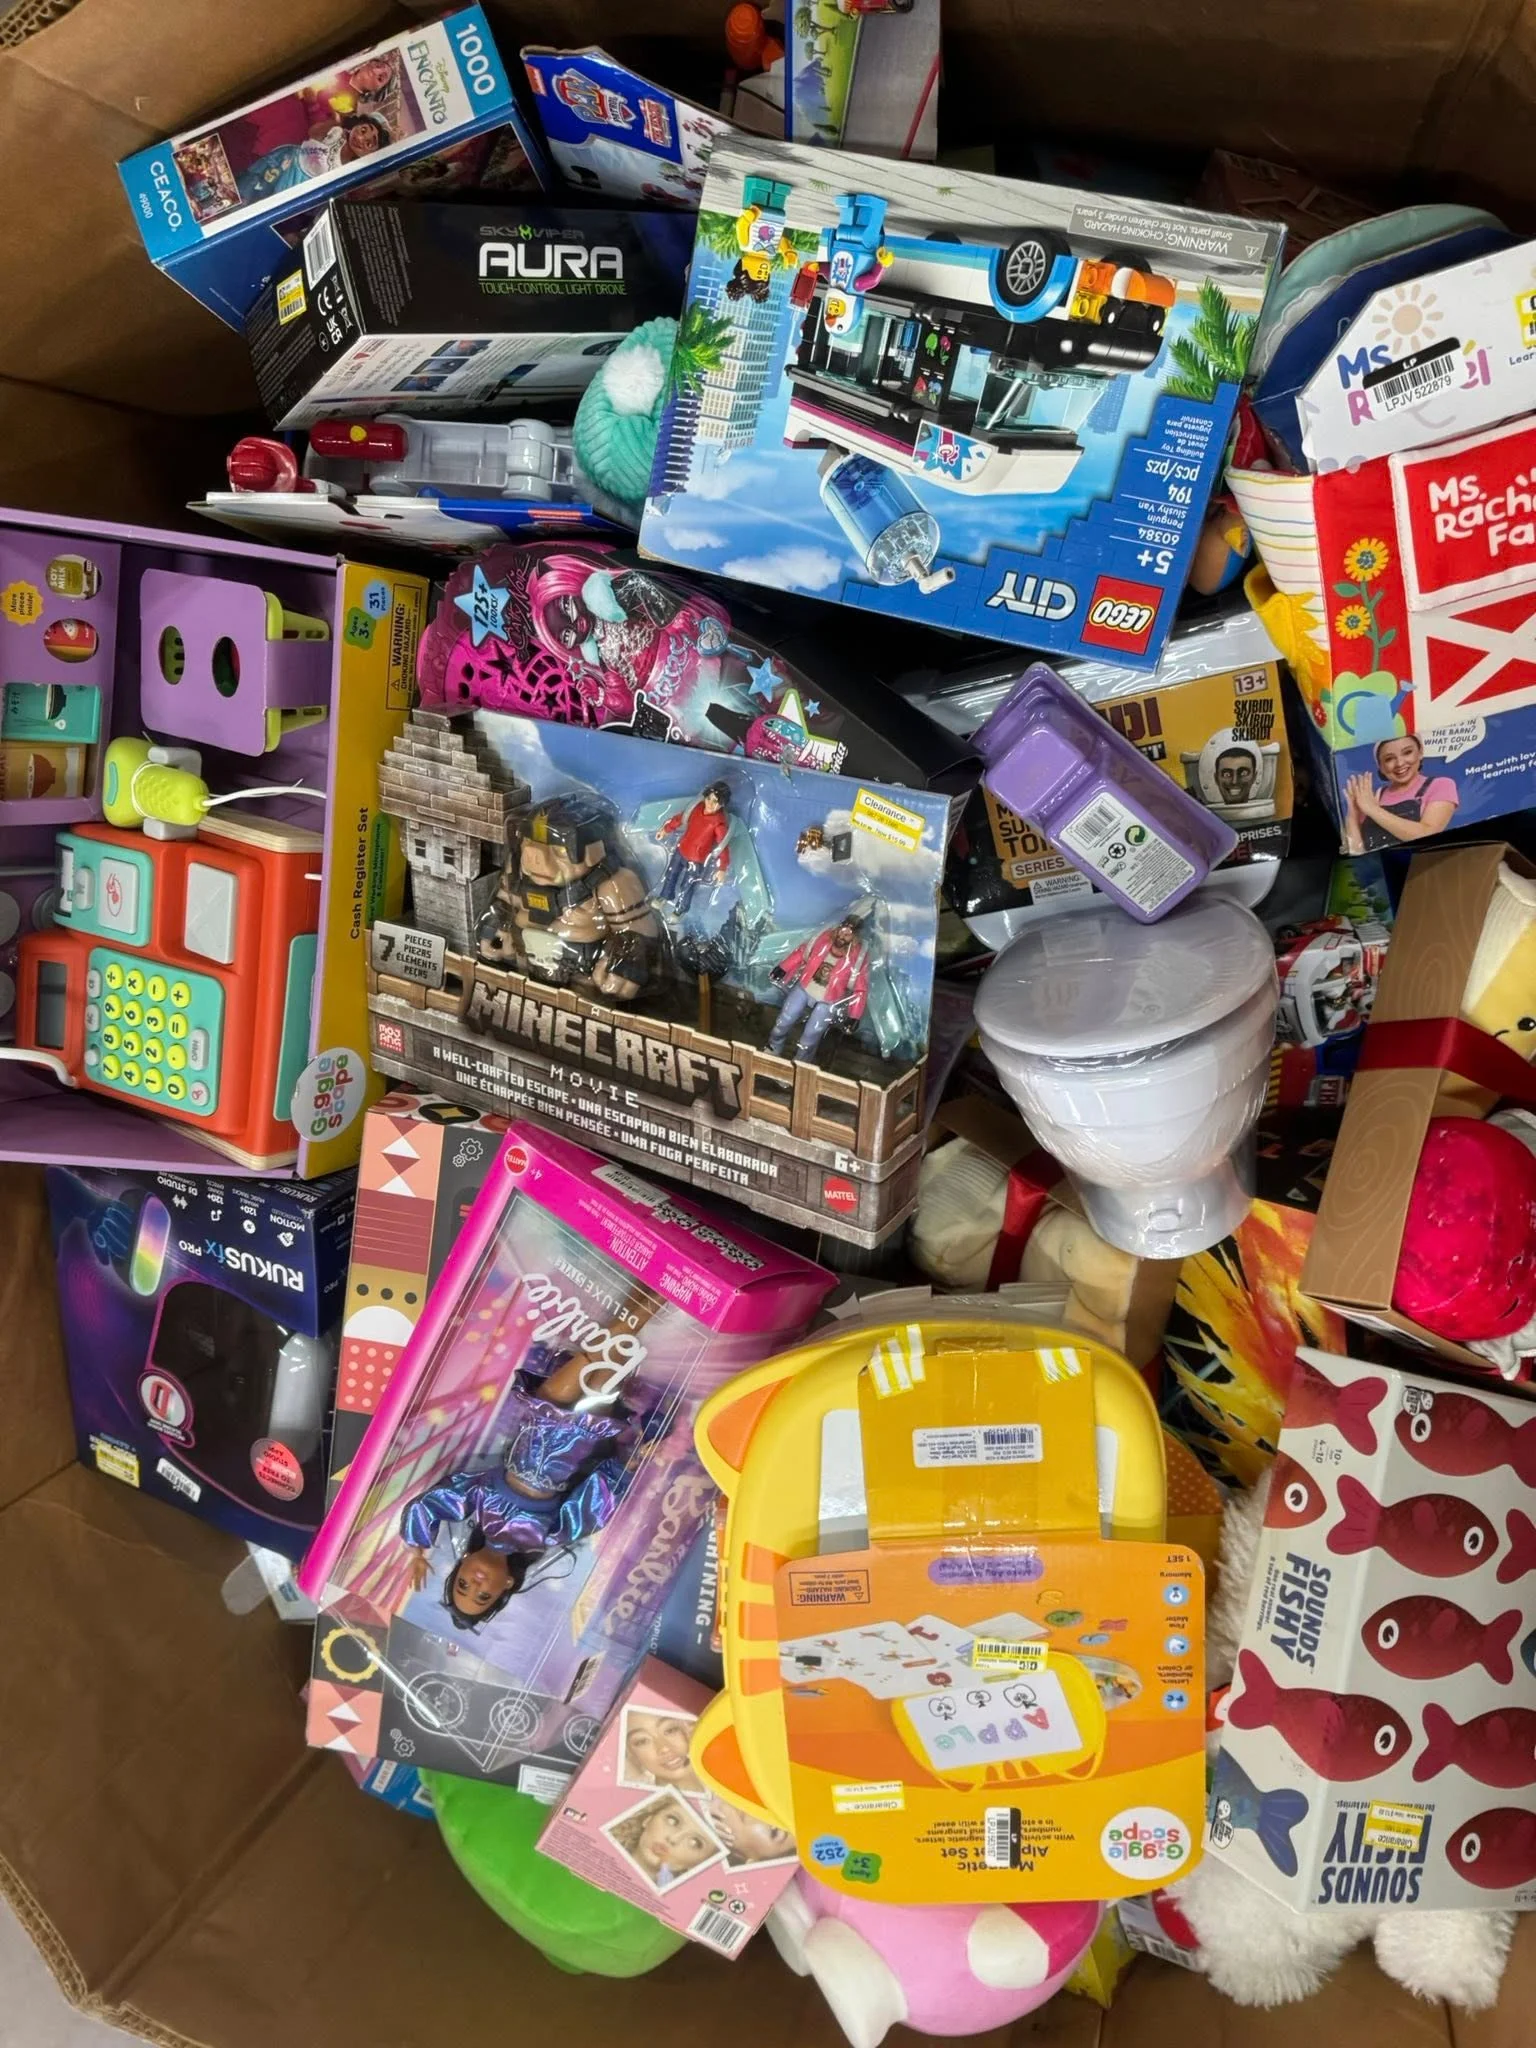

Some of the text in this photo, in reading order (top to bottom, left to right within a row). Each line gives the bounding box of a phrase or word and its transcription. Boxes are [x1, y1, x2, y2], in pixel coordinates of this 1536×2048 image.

[455, 23, 496, 96] 1000
[407, 40, 448, 126] ENCANTO
[150, 160, 183, 232] CEACO
[1121, 226, 1164, 241] CHOKING
[1167, 232, 1229, 255] WARNING:
[478, 242, 624, 279] AURA
[480, 282, 628, 296] TOUCH-CONTROL LIGHT DRONE
[1402, 357, 1419, 371] LP
[1385, 375, 1453, 413] LPJV 522879
[1146, 459, 1201, 483] pcs/pzs
[1168, 483, 1193, 505] 194
[1138, 501, 1187, 520] Slushy Van
[1434, 486, 1536, 544] Rach
[1147, 514, 1184, 529] Penguin
[1138, 528, 1180, 546] 60384
[1488, 520, 1536, 557] Fa
[1136, 550, 1175, 575] 5+
[369, 588, 380, 610] 31
[474, 583, 490, 629] 125+
[985, 571, 1078, 622] CITY
[1091, 600, 1154, 632] LEGO
[358, 619, 370, 639] 3+
[391, 603, 406, 667] WARNING:
[1235, 675, 1266, 692] 13+
[1234, 699, 1273, 714] SKIBIDI
[1235, 713, 1275, 728] SKIBIDI
[1231, 727, 1271, 742] SKIBIDI
[1465, 752, 1536, 776] Made with lov
[1483, 764, 1526, 780] learning
[864, 796, 907, 823] Clearance
[1236, 826, 1282, 843] RPRISES
[350, 807, 369, 940] Cash Register Set
[1015, 857, 1065, 876] SERIES
[379, 934, 396, 962] 7
[404, 933, 432, 949] PIECES
[104, 1002, 116, 1013] 9
[124, 1009, 136, 1020] 6
[146, 1016, 159, 1027] 3
[103, 1033, 114, 1044] 8
[123, 1039, 135, 1051] 5
[466, 981, 743, 1112] MINECRAFT
[145, 1047, 157, 1058] 2
[103, 1063, 114, 1074] 7
[124, 1070, 135, 1082] 4
[145, 1077, 157, 1085] 1
[167, 1083, 180, 1095] 0
[550, 1063, 640, 1109] MOVIE
[311, 1056, 334, 1136] Giggle
[328, 1053, 353, 1129] scape
[433, 1046, 778, 1178] A WELL-CRAFTED ESCAPE UNA ESCAPADA BIEN ELABORADA
[456, 1070, 478, 1088] UNE
[537, 1098, 564, 1121] BIEN
[620, 1130, 649, 1152] UMA
[649, 1141, 682, 1164] FUGA
[684, 1153, 749, 1186] PERFEITA
[834, 1153, 861, 1173] 6+
[157, 1175, 187, 1193] STUDIO
[824, 1188, 857, 1203] MATTEL
[269, 1213, 305, 1232] MOTION
[178, 1240, 202, 1256] PRO
[583, 1279, 640, 1330] DELUXE
[521, 1271, 649, 1402] Barbie
[603, 1474, 716, 1637] Barbie
[796, 1591, 847, 1604] WARNING:
[1270, 1552, 1312, 1661] FISHY
[1296, 1563, 1332, 1669] SOUNDS
[853, 1799, 899, 1811] Clearance
[1054, 1833, 1075, 1842] With
[1109, 1823, 1180, 1844] scape
[1377, 1834, 1413, 1849] Clearance
[815, 1846, 845, 1861] 252
[940, 1847, 968, 1859] Set
[1109, 1839, 1184, 1860] Giggle
[851, 1854, 872, 1869] 3+
[957, 1860, 1035, 1873] Metic
[1318, 1866, 1423, 1904] SOUNDS
